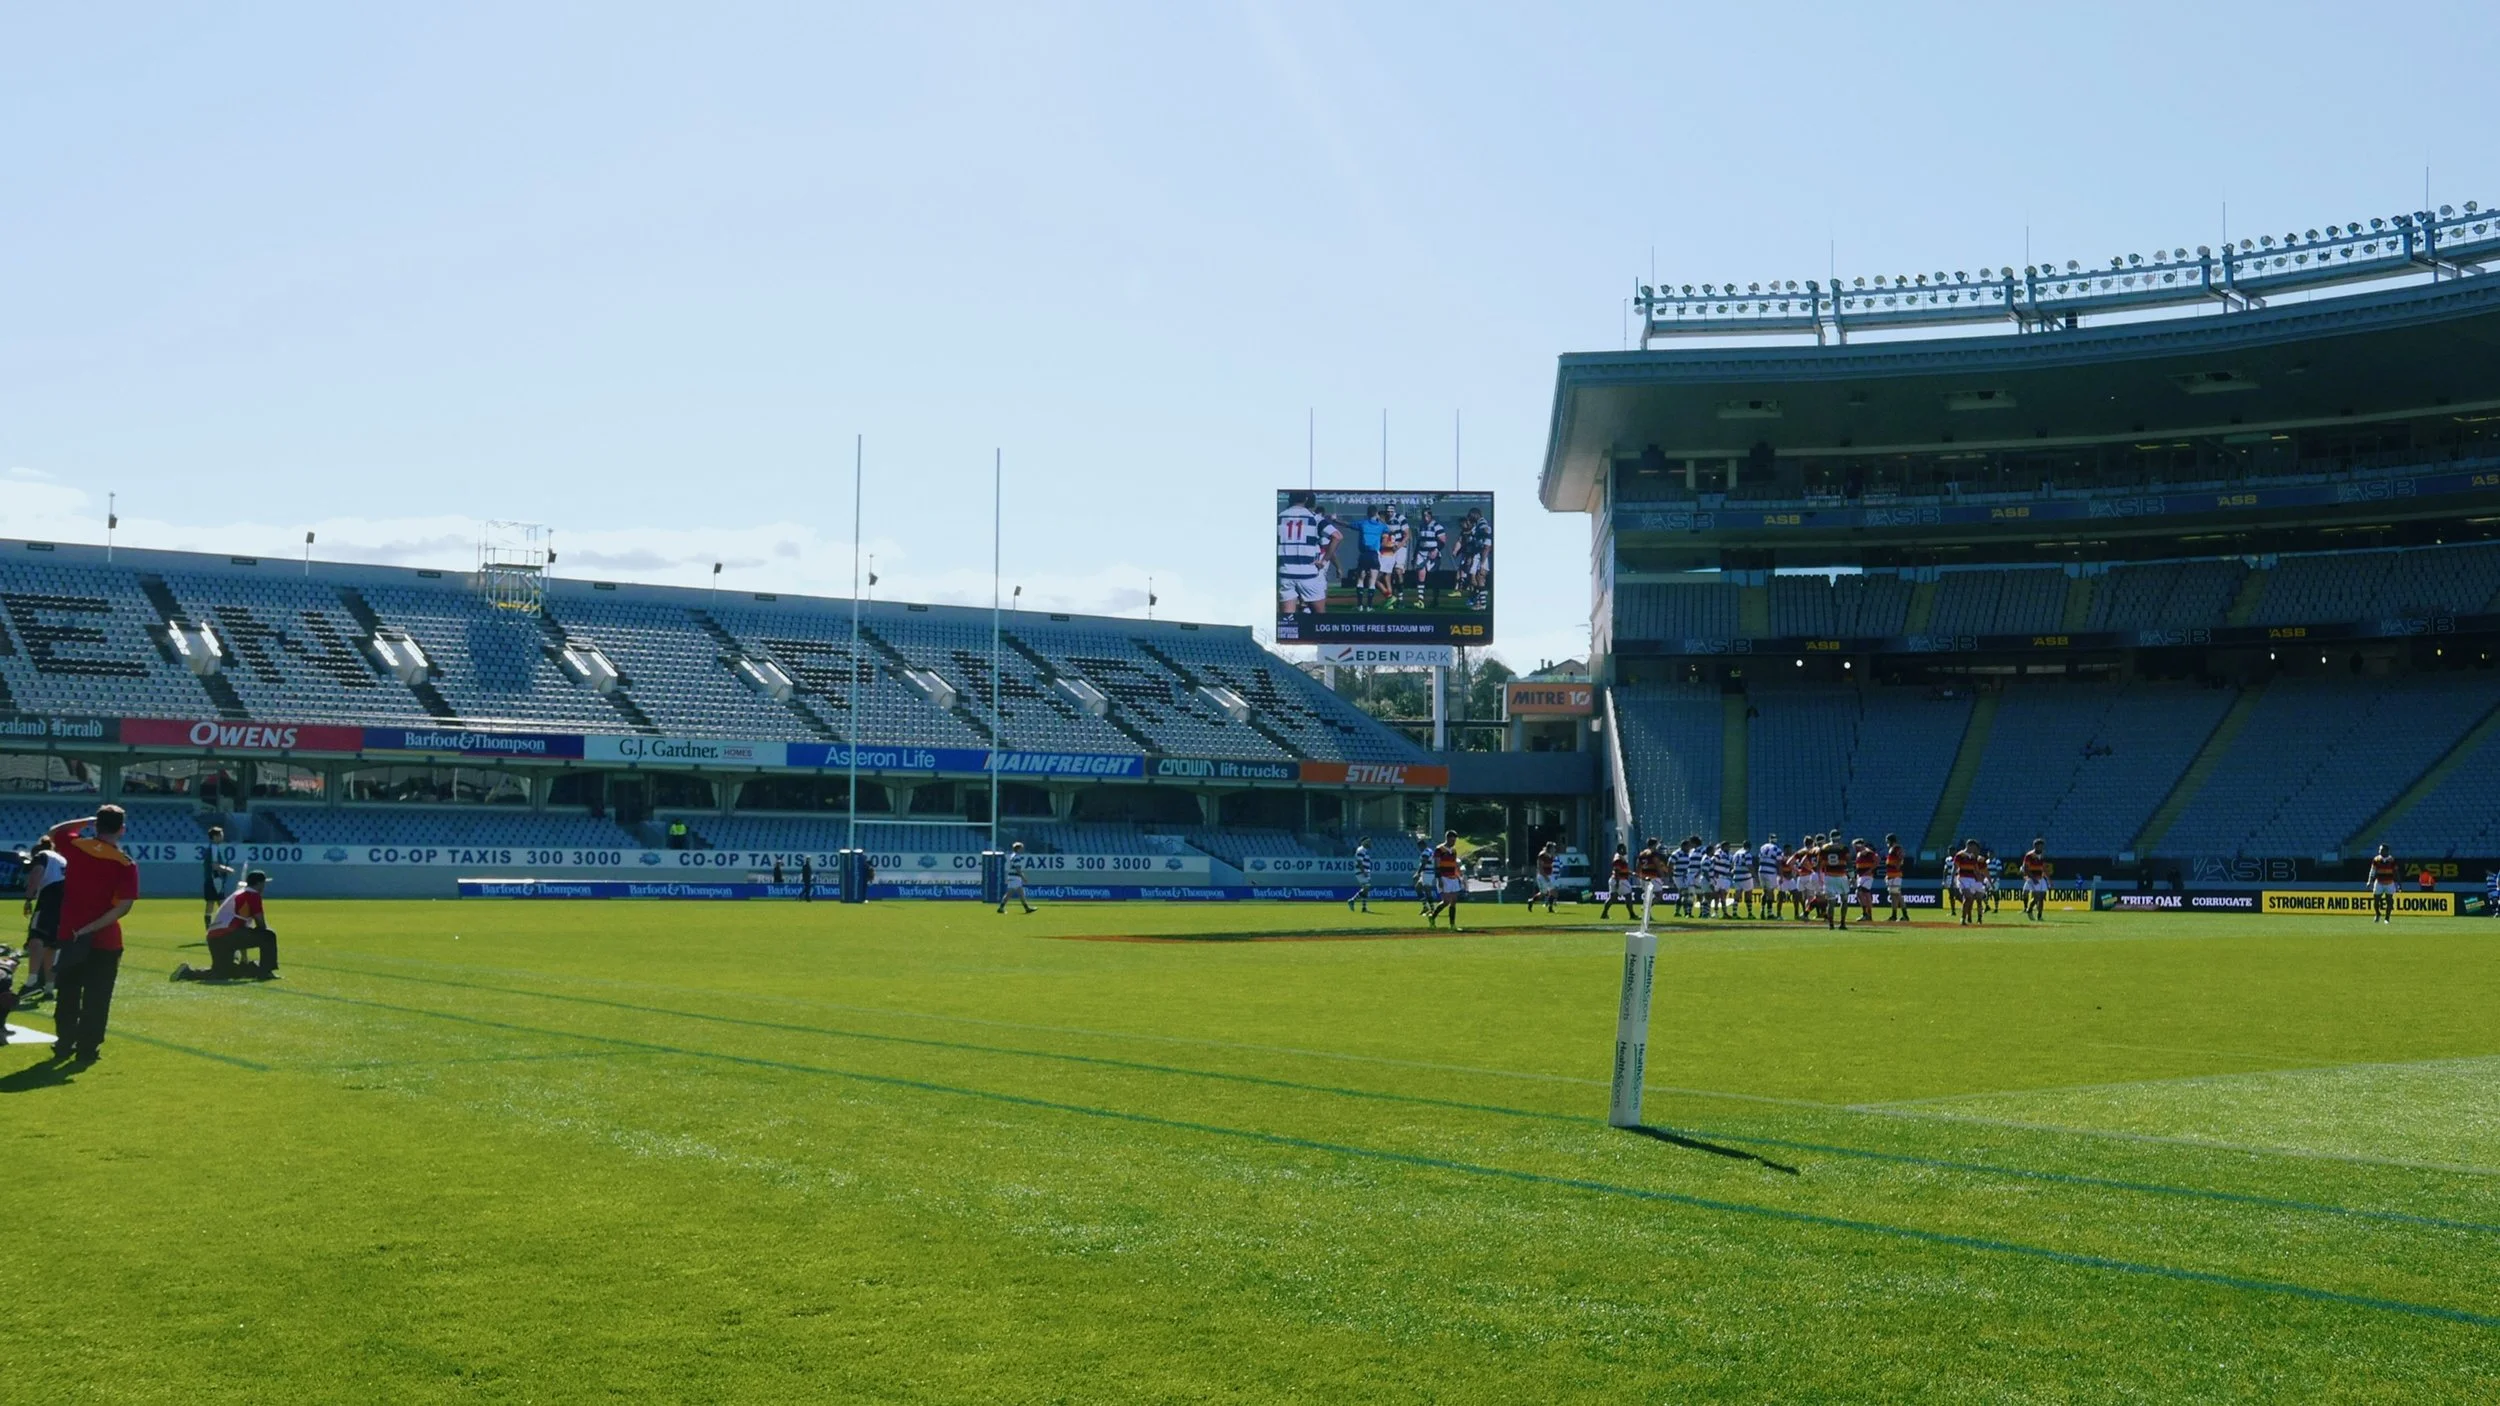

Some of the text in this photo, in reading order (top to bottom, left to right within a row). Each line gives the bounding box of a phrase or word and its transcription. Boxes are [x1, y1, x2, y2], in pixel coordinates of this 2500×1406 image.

[2217, 494, 2257, 506] ASB
[1992, 507, 2030, 518] ASB
[1764, 514, 1801, 525] ASB
[1286, 519, 1303, 541] 11
[1315, 624, 1330, 632] LOG
[1331, 624, 1340, 632] IN
[1341, 624, 1351, 632] TO
[1352, 624, 1366, 632] THE
[1367, 624, 1386, 632] FREE
[1387, 624, 1418, 633] STADIUM
[1450, 625, 1483, 635] ASB
[2269, 628, 2306, 638] ASB
[1805, 640, 1840, 650] ASB
[2033, 637, 2068, 646] ASB
[1356, 651, 1449, 662] EDEN PARK
[1512, 692, 1591, 706] MITRE 10
[51, 716, 103, 738] Herald
[190, 721, 298, 748] OWENS
[619, 738, 753, 760] G.J. Gardner. HOMES
[902, 748, 935, 768] Life
[984, 753, 1136, 775] MAINFREIGHT
[1158, 758, 1288, 780] CROWN lift trucks
[1345, 764, 1404, 784] STIHL
[194, 845, 236, 861] 30
[248, 846, 303, 862] 3000
[368, 847, 622, 866] CO-OP TAXIS 300 3000
[679, 851, 740, 867] CO-OP
[818, 853, 840, 868] 30
[1827, 854, 1839, 865] 8
[1076, 857, 1105, 870] 300
[1112, 857, 1152, 870] 3000
[1273, 860, 1313, 871] CO-OP
[1319, 860, 1354, 871] TAXIS
[1385, 861, 1414, 872] 3000
[2049, 890, 2088, 902] LOOKING
[2121, 895, 2154, 906] TRUE
[2155, 896, 2182, 907] OAK
[2192, 897, 2253, 907] CORRUGATE
[2269, 895, 2325, 910] STRONGER
[2327, 896, 2350, 910] AND
[2396, 897, 2448, 912] LOOKING
